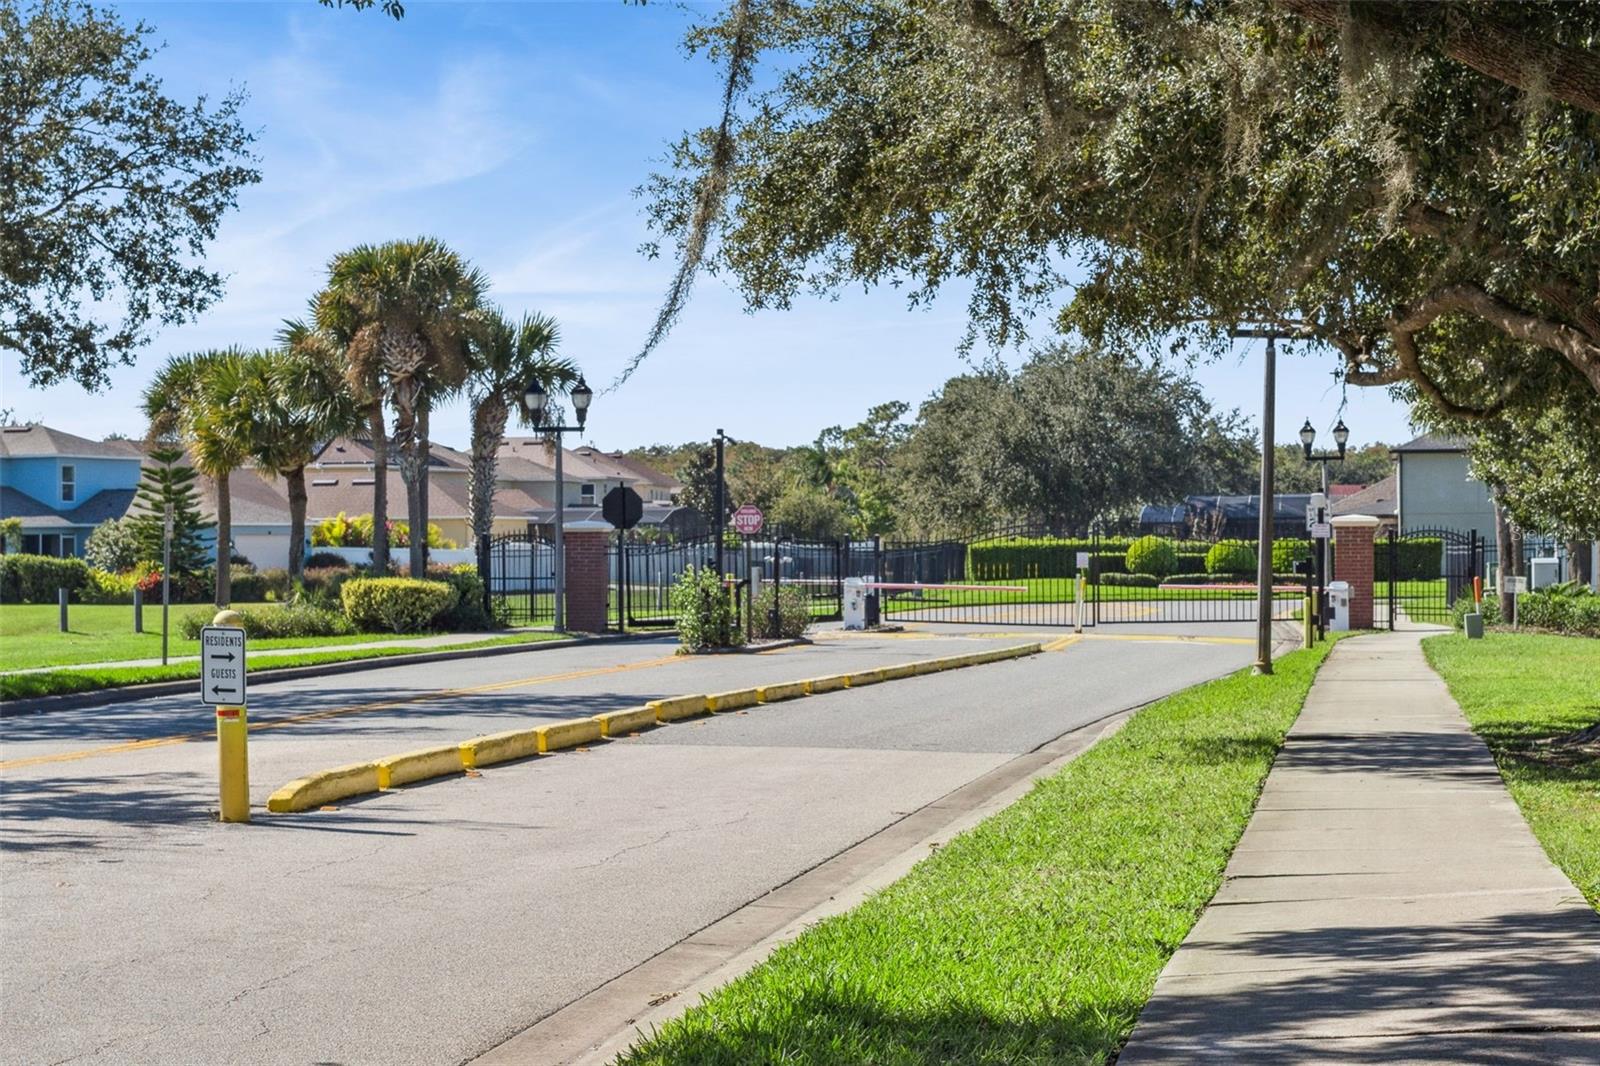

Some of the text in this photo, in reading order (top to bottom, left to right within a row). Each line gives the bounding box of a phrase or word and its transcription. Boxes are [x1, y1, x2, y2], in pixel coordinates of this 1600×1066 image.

[737, 515, 760, 525] STOP
[205, 636, 242, 647] RESIDENTS
[211, 668, 236, 679] GUESTS
